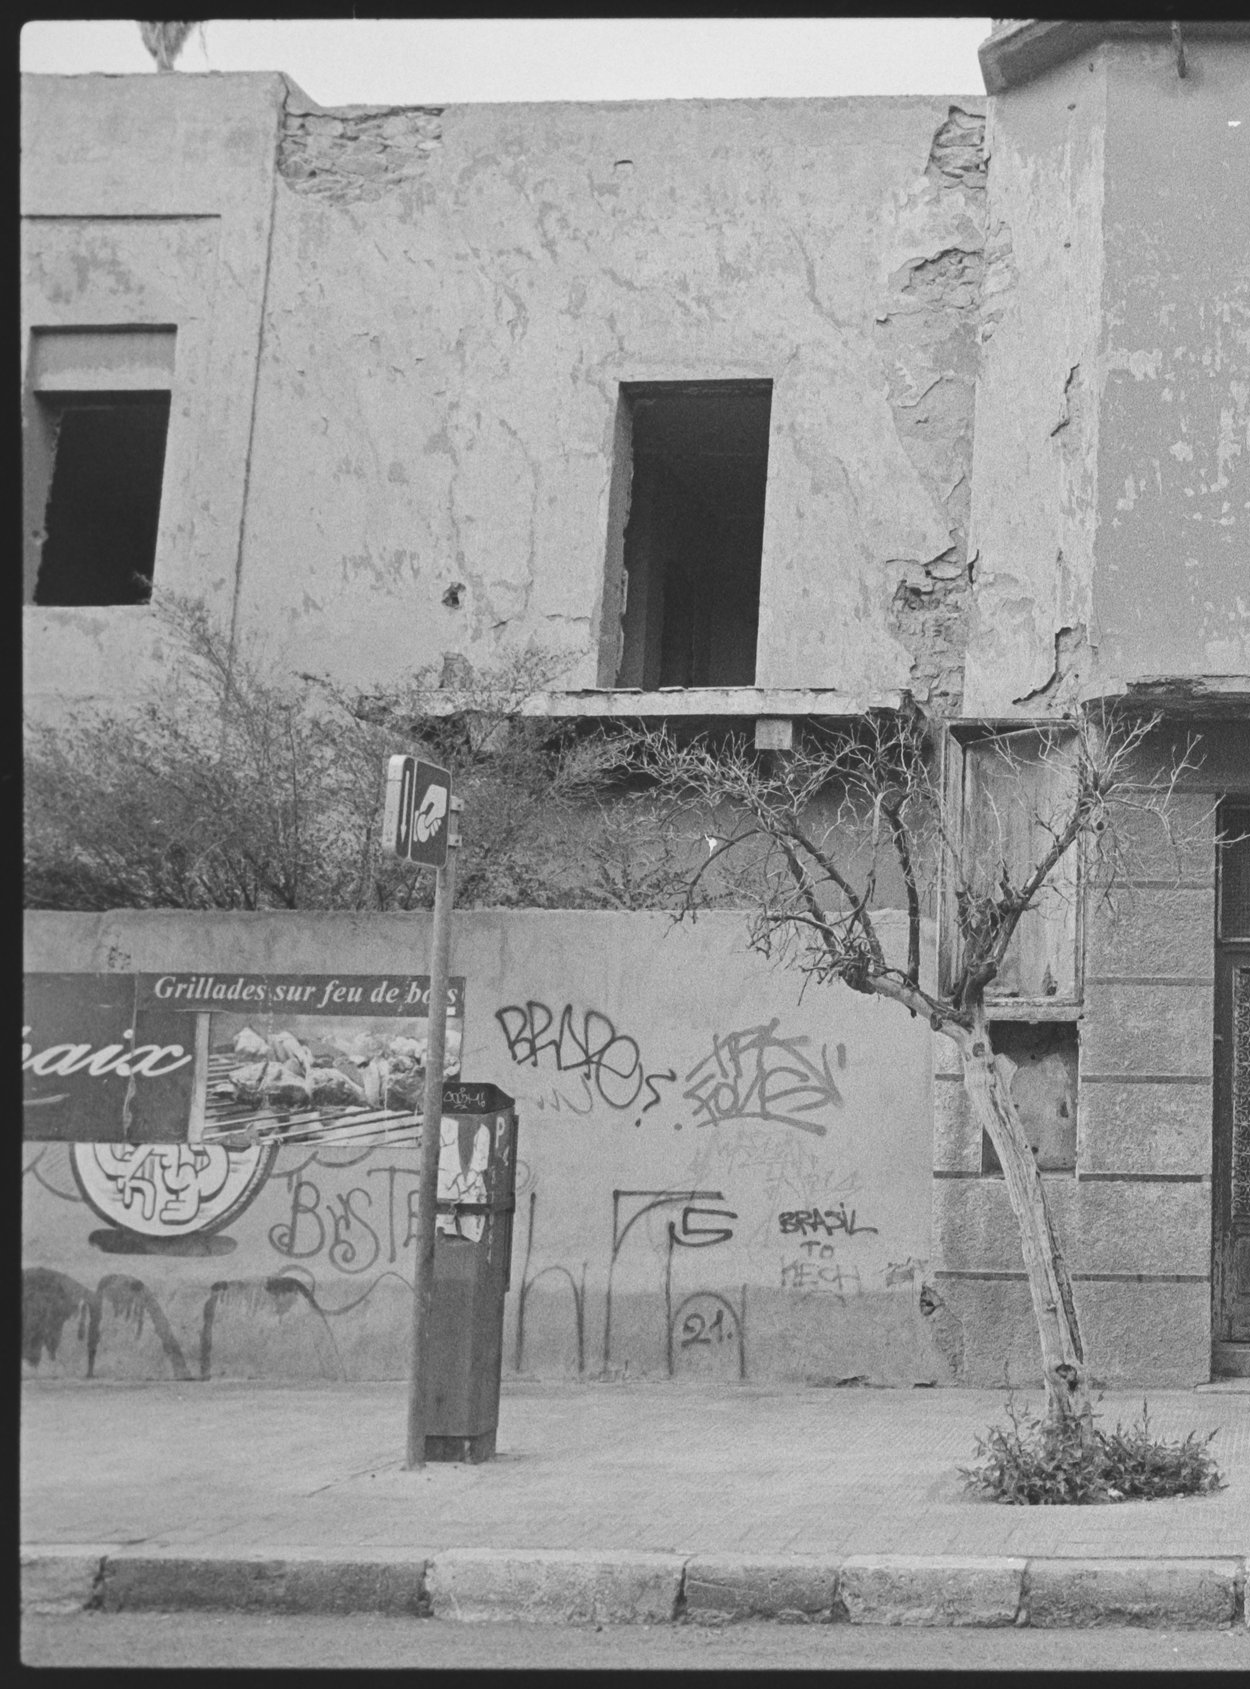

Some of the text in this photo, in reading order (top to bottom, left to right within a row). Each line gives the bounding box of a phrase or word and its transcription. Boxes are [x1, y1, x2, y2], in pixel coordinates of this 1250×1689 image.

[154, 975, 458, 1009] Grillades sur feu de bos
[22, 1026, 193, 1077] aix
